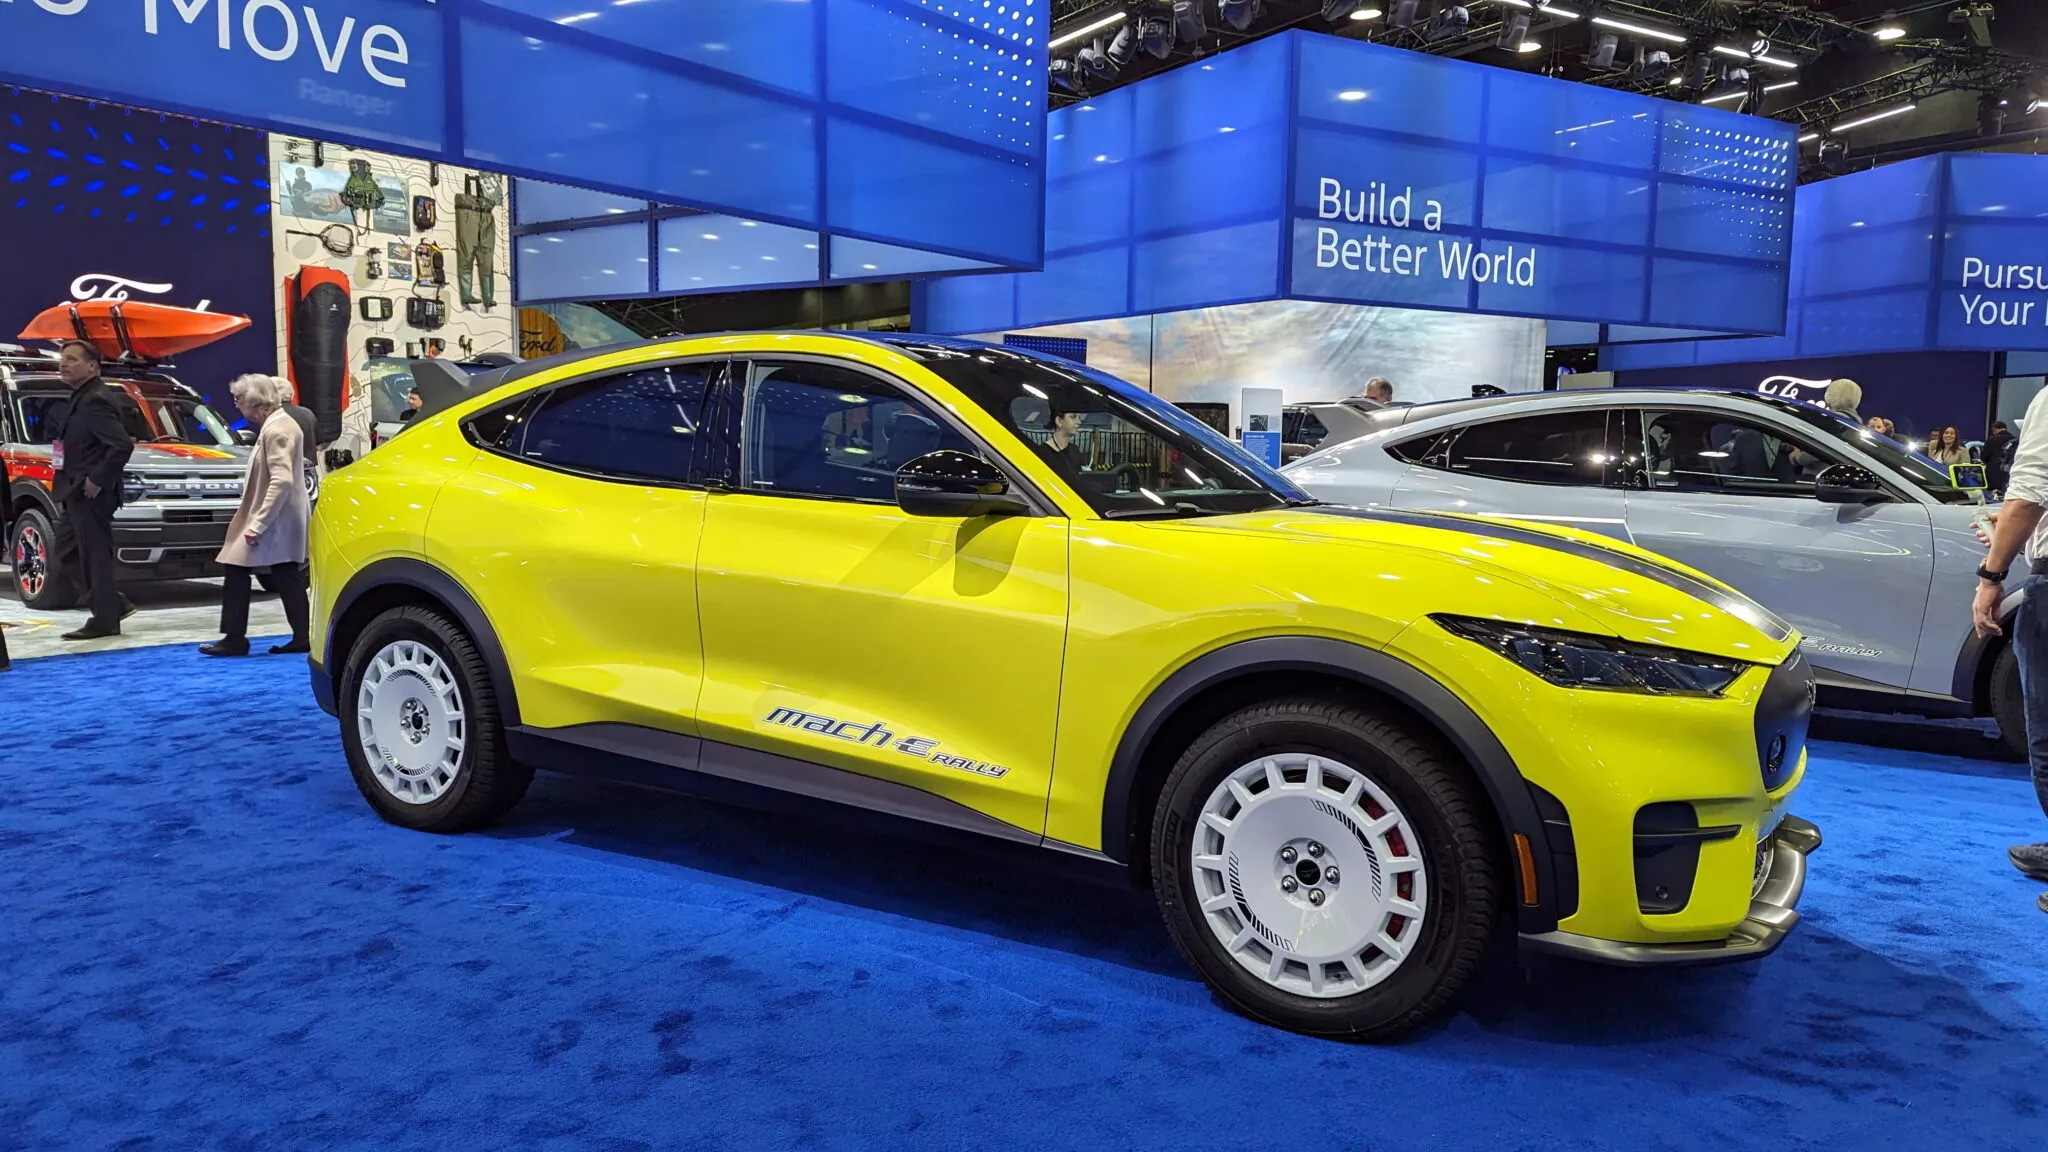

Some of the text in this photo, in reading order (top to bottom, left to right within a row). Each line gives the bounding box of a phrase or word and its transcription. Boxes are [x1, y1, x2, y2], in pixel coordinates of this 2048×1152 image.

[299, 77, 395, 115] Ranger
[1318, 176, 1442, 232] Build a
[1316, 227, 1536, 287] Better World
[1959, 293, 2035, 326] Your
[928, 752, 1011, 778] RALLY
